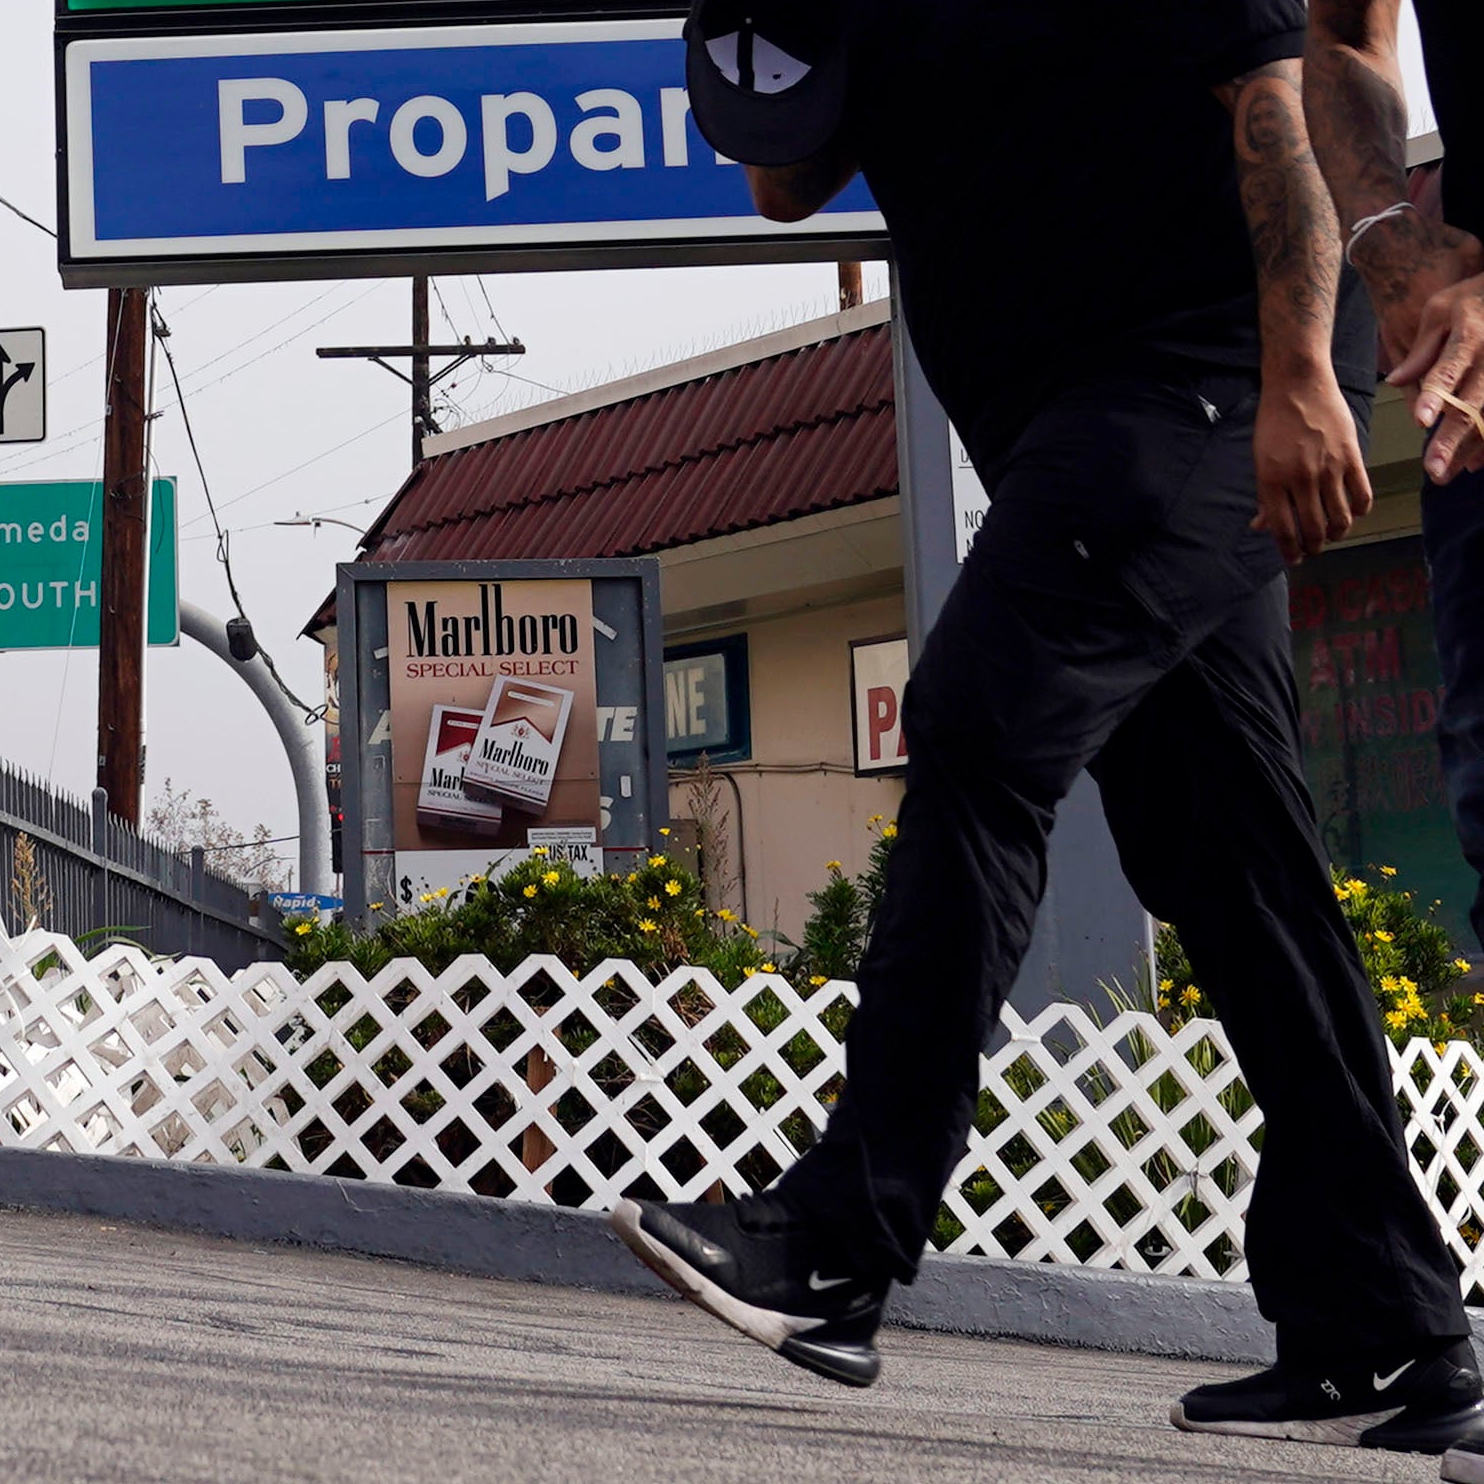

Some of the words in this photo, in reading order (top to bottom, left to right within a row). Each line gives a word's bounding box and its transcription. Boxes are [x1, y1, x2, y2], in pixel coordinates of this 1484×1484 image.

[405, 583, 579, 659] Marlboro
[406, 660, 494, 679] SPECIAL
[499, 659, 579, 677] SELECT
[1308, 624, 1403, 691] ATM
[1334, 684, 1447, 742] INSID
[479, 738, 550, 776] Marlboro
[476, 760, 510, 776] SPECIAL
[513, 771, 546, 786] SELECT
[427, 789, 461, 801] SPECIAL
[568, 845, 588, 861] TAX
[273, 895, 317, 910] Rapid
